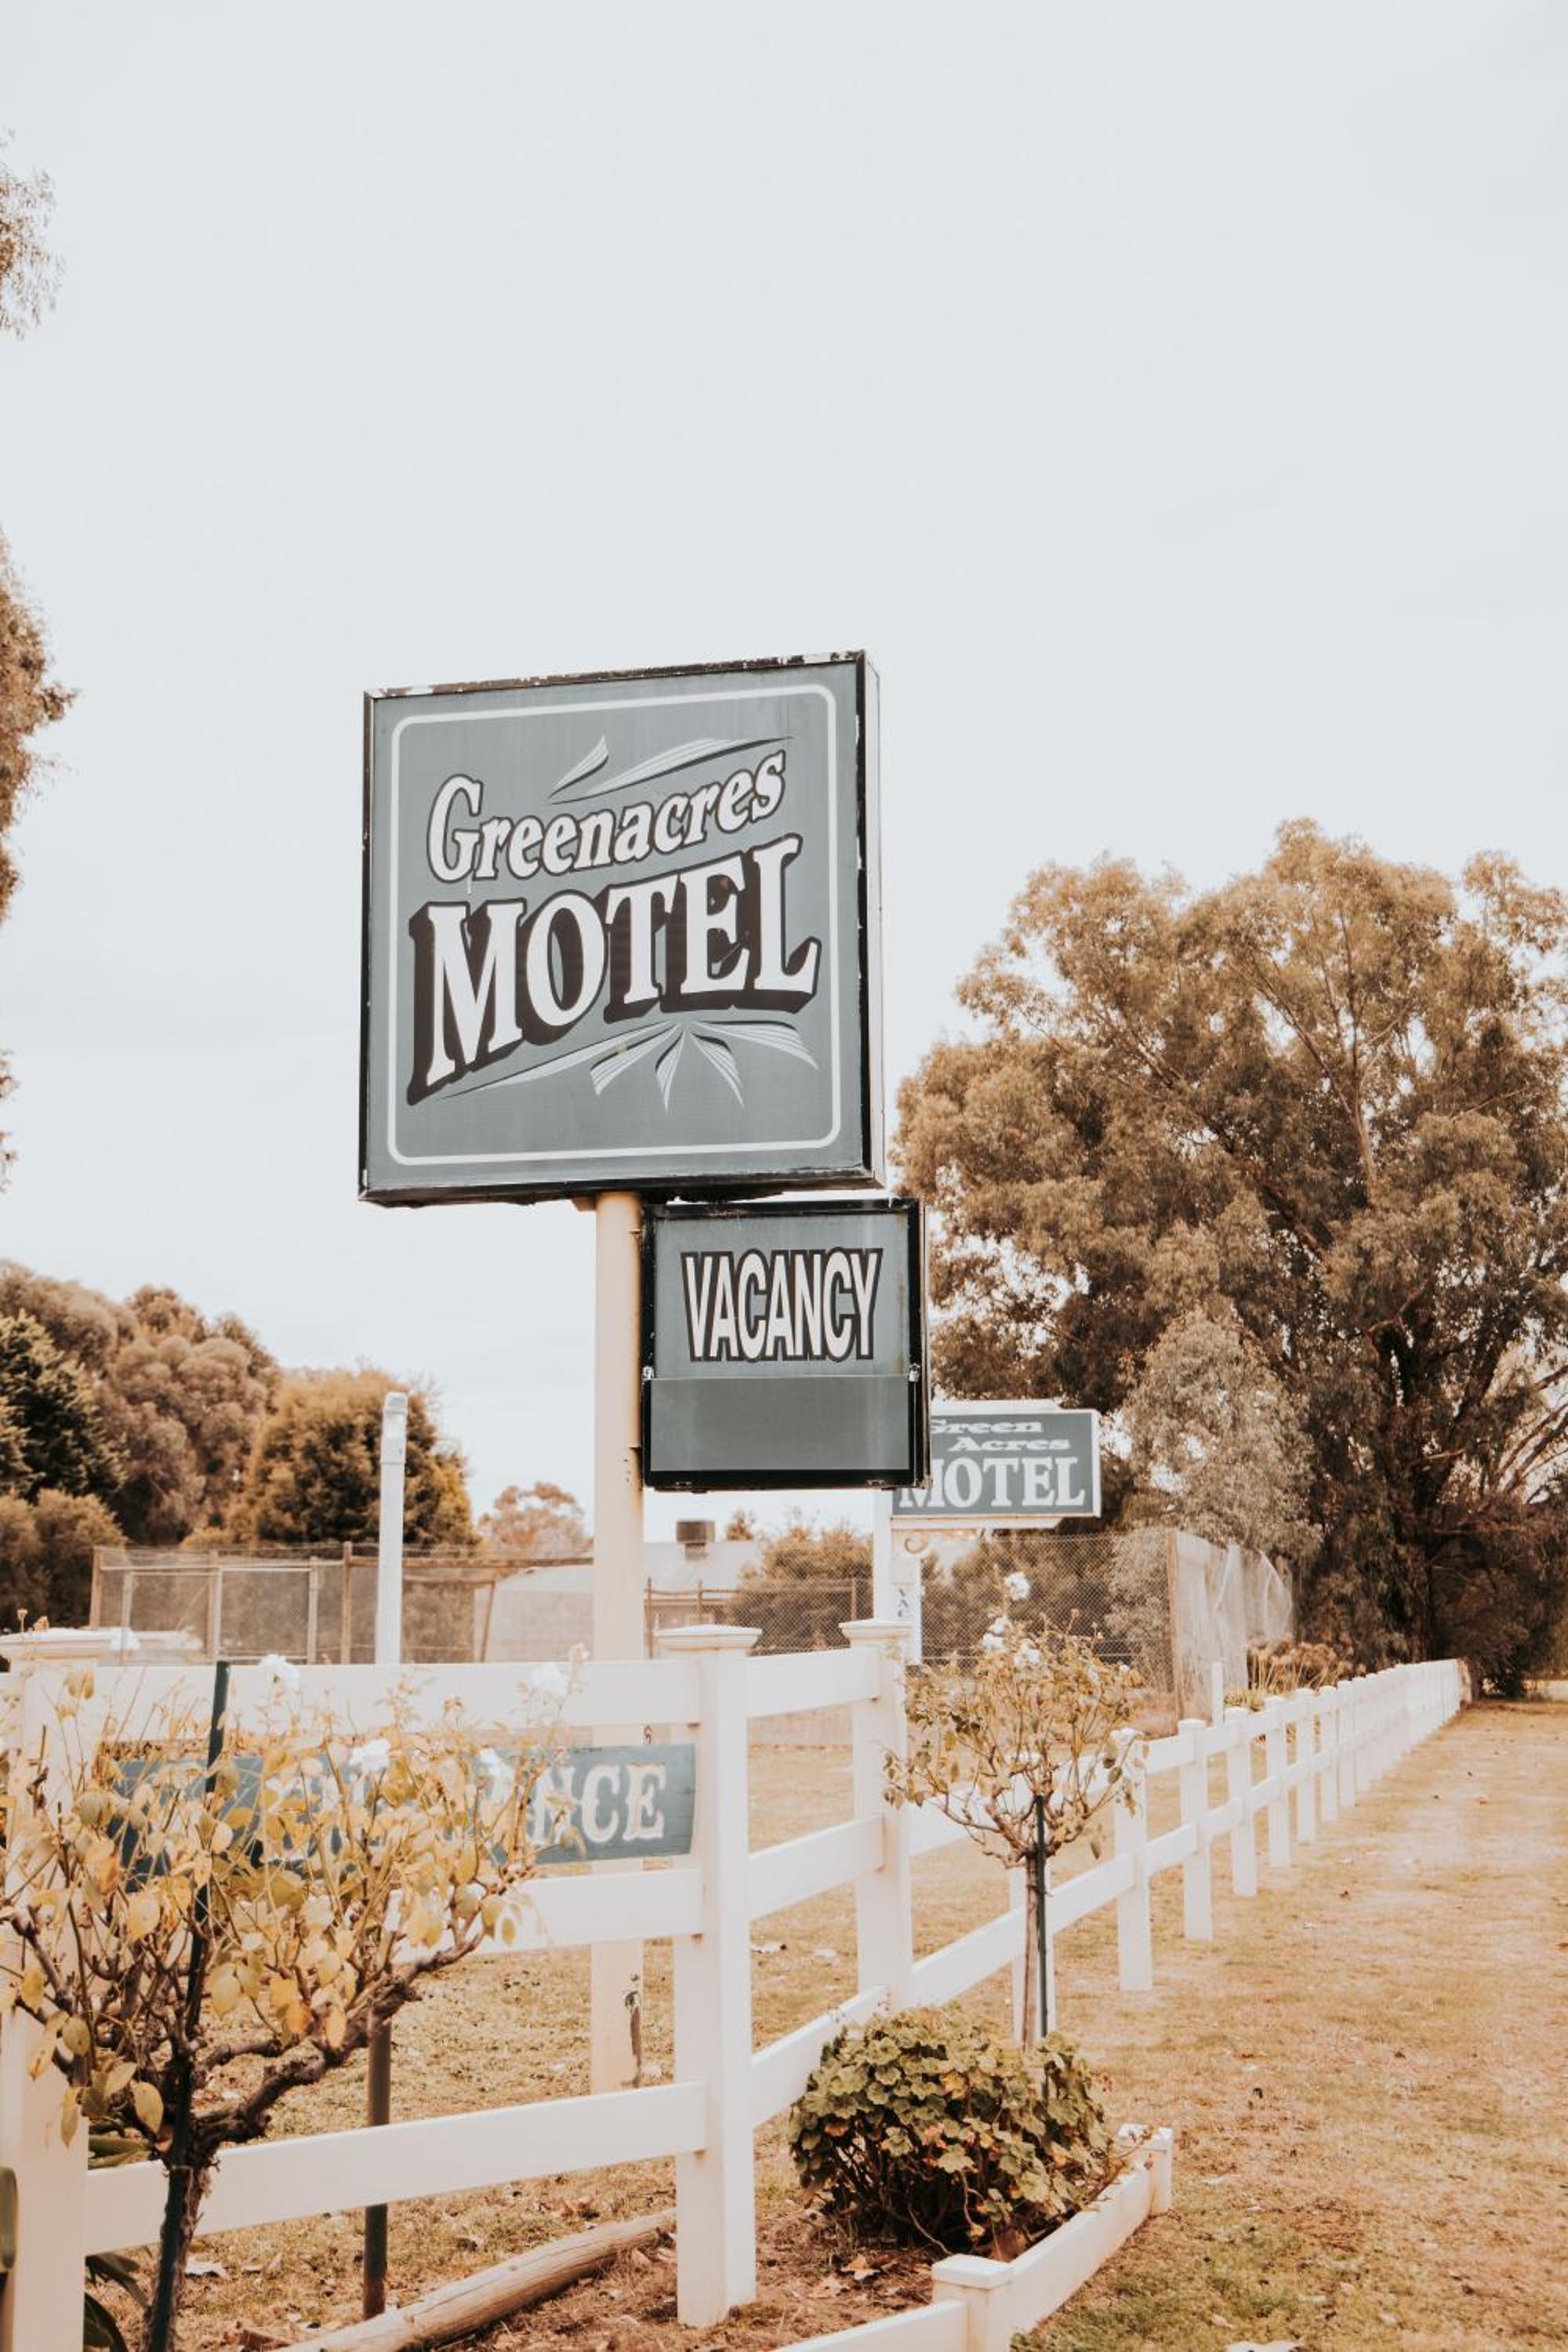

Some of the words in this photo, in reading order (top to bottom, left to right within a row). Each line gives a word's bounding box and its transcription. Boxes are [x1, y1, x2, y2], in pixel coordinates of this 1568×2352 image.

[427, 749, 786, 884] Greenacres
[407, 833, 822, 1105] MOTEL
[680, 1247, 884, 1363] VACANCY
[947, 1436, 1072, 1451] Acres
